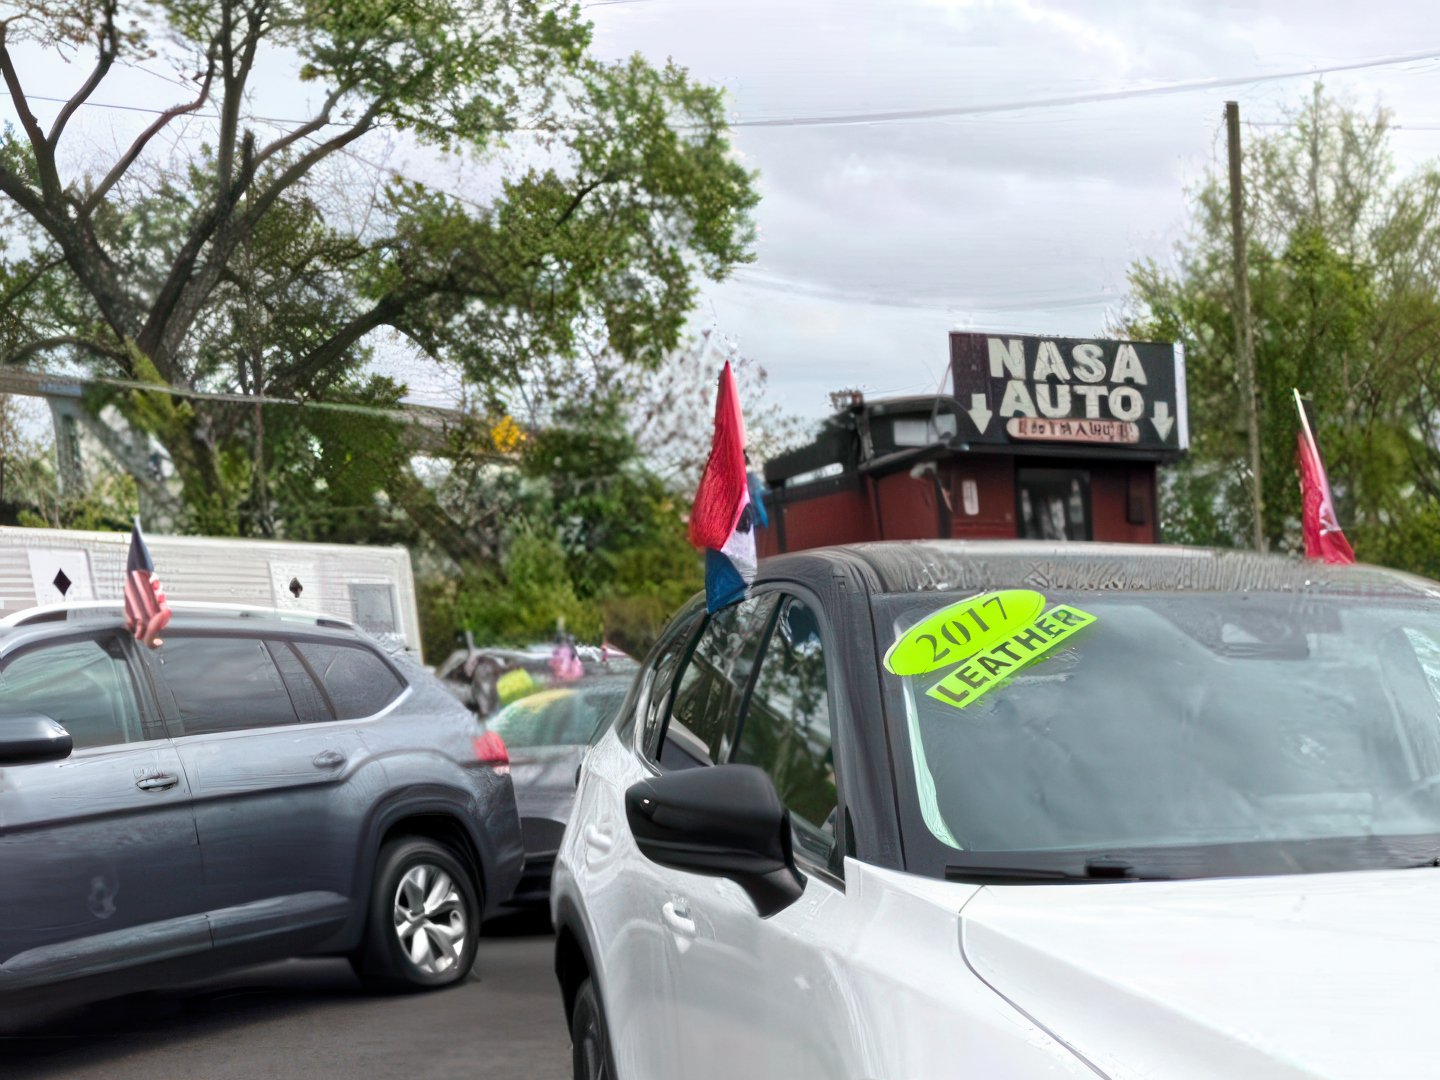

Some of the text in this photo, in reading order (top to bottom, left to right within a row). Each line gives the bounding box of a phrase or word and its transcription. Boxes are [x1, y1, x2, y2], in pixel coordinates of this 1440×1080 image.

[987, 338, 1147, 386] NASA
[1000, 380, 1145, 422] AUTO
[915, 596, 1008, 663] 2017
[936, 609, 1087, 703] LEATHER
